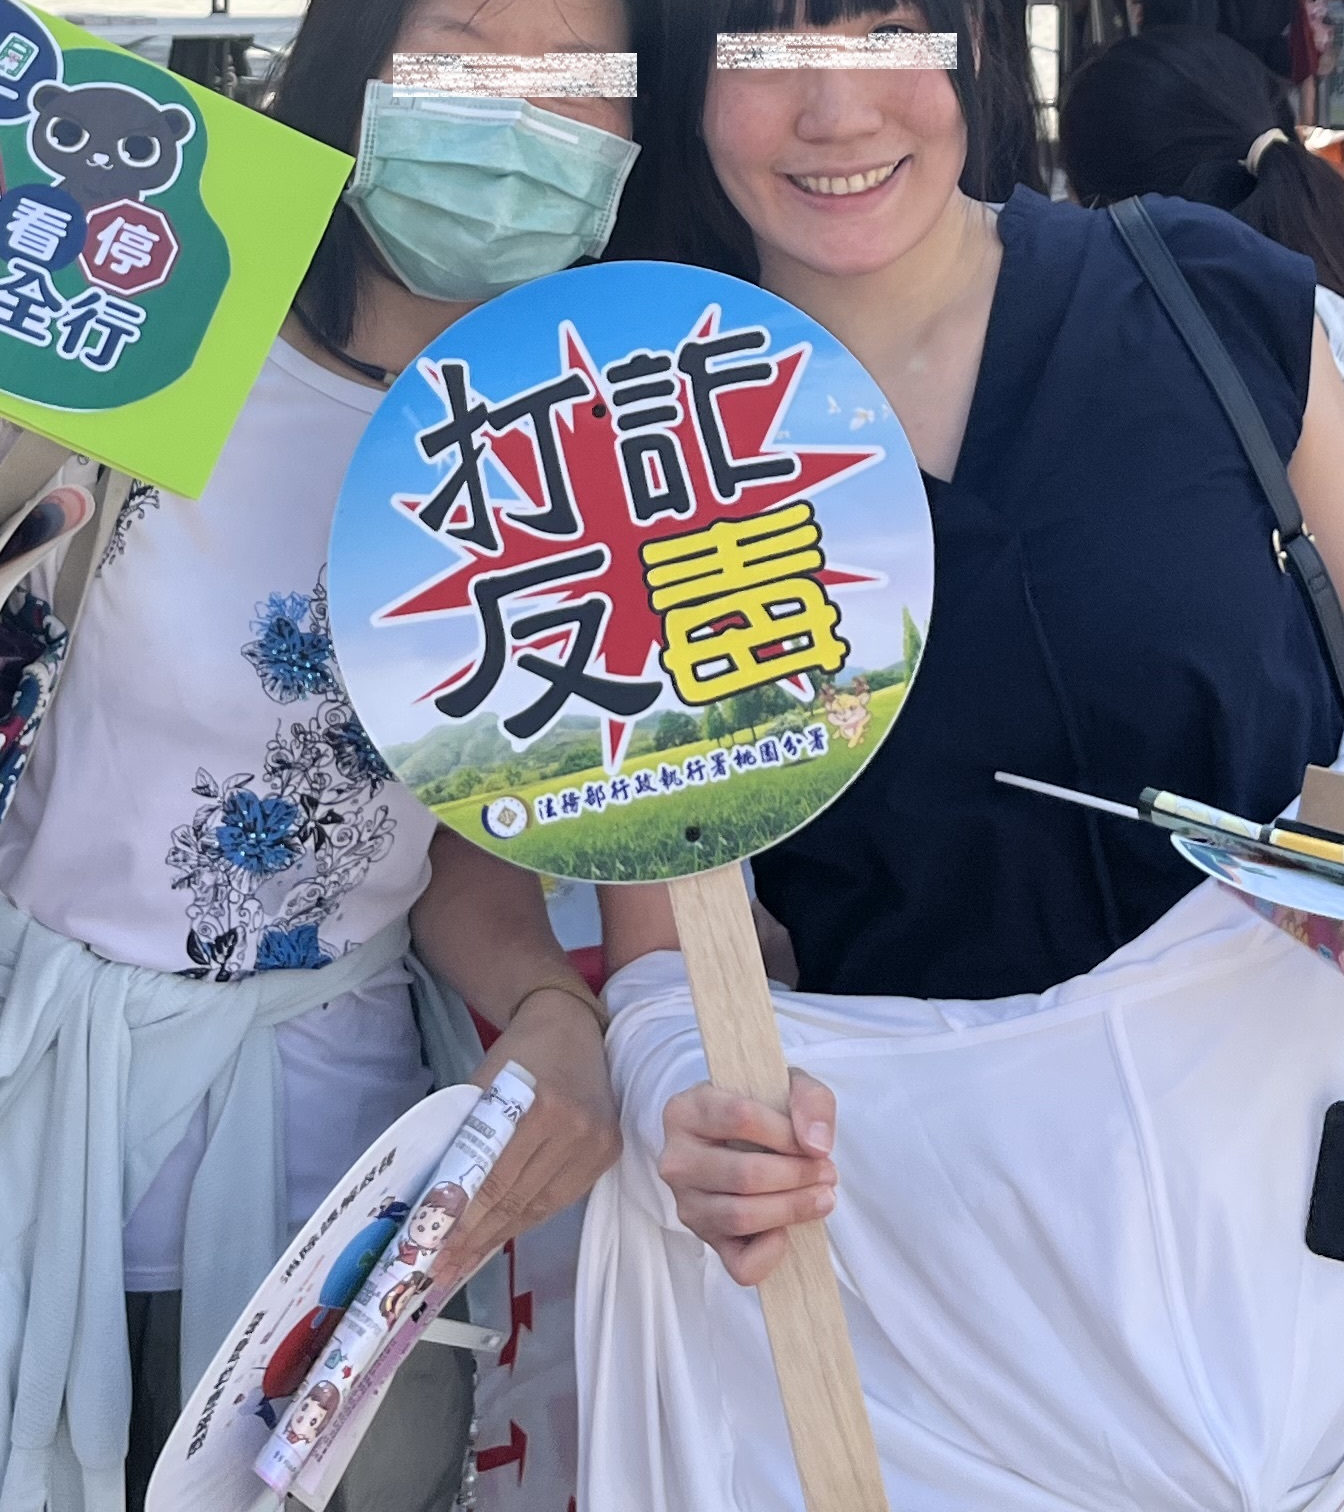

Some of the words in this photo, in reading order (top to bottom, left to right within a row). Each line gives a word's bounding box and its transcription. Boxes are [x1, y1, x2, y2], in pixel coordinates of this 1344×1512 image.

[433, 501, 851, 740] 反毒
[535, 725, 830, 822] 法務部行政執行署桃園分署
